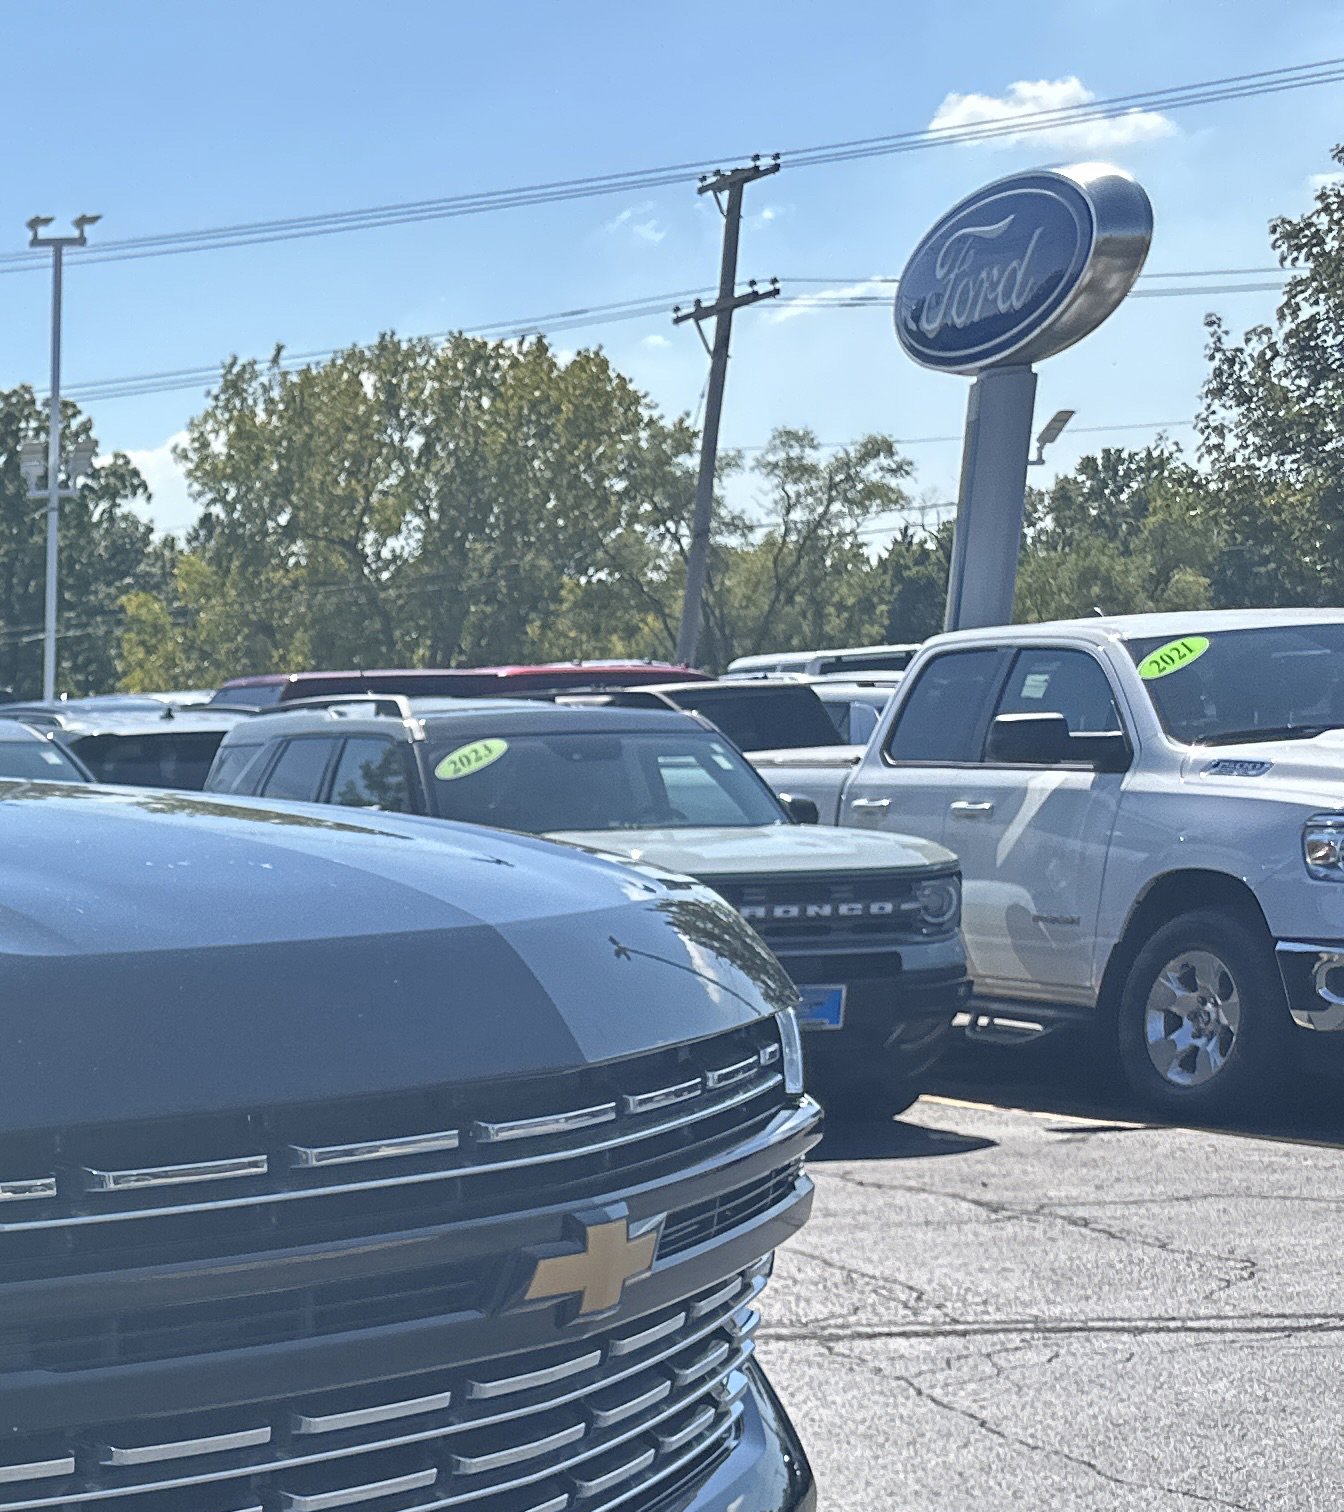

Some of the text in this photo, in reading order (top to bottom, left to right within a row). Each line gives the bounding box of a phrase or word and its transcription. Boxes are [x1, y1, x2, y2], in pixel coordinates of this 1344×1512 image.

[918, 213, 1045, 338] Ford
[1148, 641, 1194, 674] 2021
[739, 902, 893, 919] RONCO
